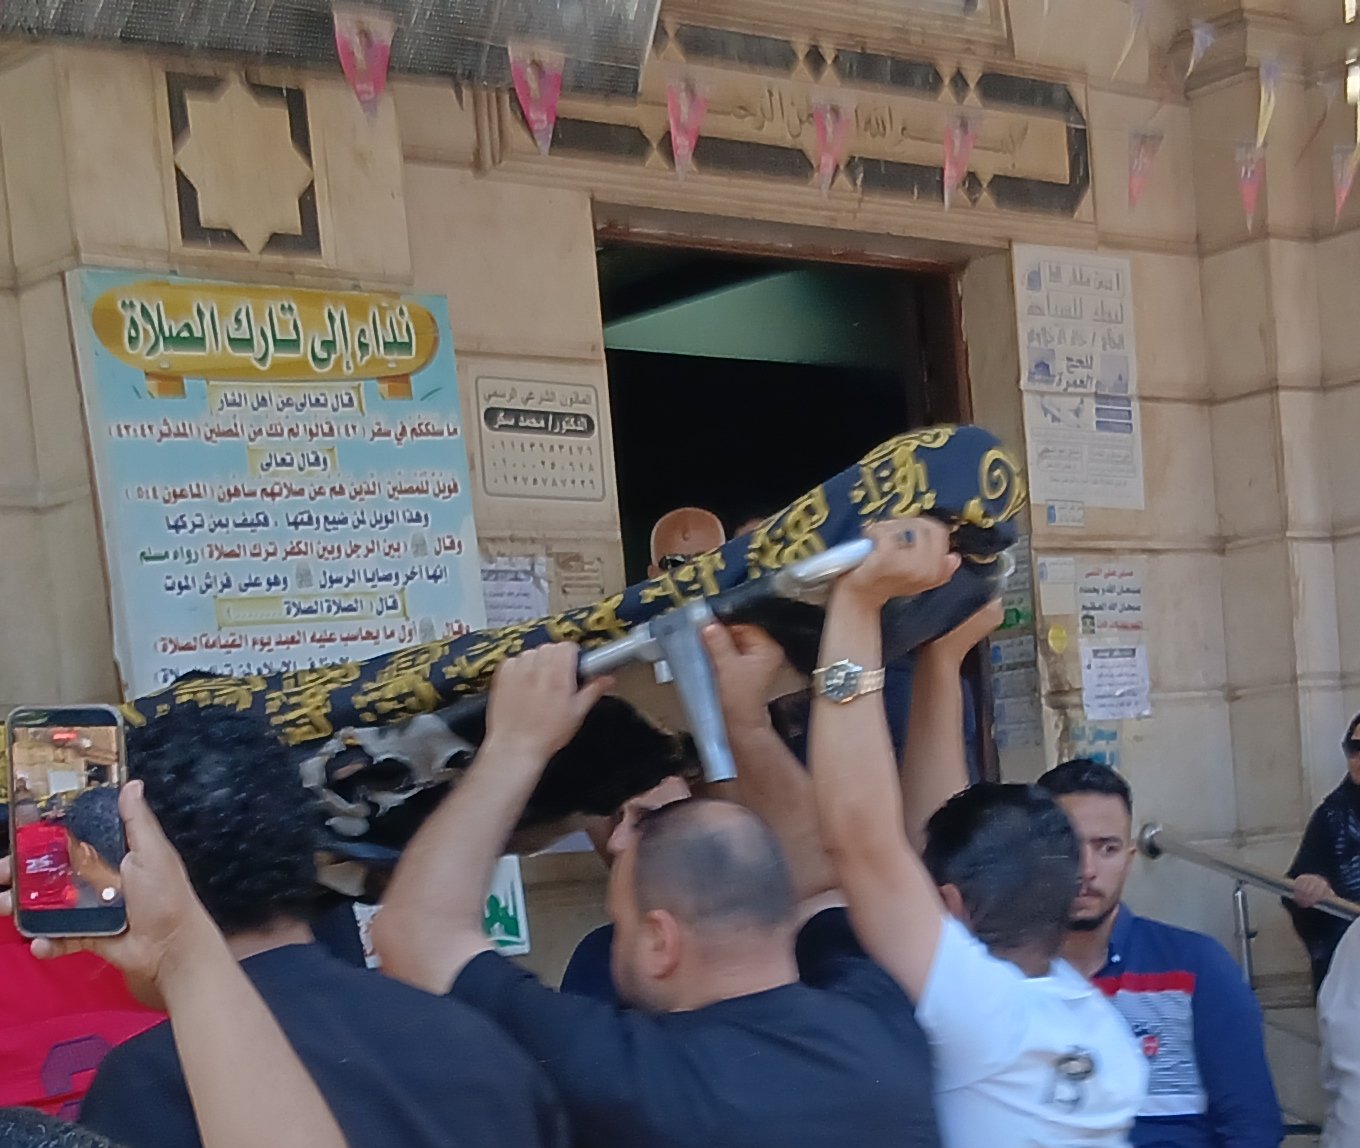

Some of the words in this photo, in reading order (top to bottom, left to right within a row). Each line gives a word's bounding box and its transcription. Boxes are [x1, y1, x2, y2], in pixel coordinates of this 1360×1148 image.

[119, 299, 221, 360] الصلاة
[225, 300, 305, 369] تارك
[309, 305, 353, 373] إلى
[356, 302, 415, 363] نداء
[216, 391, 249, 412] النار
[275, 394, 294, 412] عن
[294, 391, 328, 413] تعالى
[330, 391, 356, 413] قال
[203, 419, 246, 445] المصلين
[287, 422, 300, 441] لم
[303, 420, 336, 443] قالوا
[369, 420, 392, 442] سقر
[446, 423, 459, 438] ما
[518, 415, 546, 429] محمد
[248, 424, 264, 443] من
[259, 451, 296, 473] تعالى
[297, 451, 328, 472] وقال
[216, 482, 259, 504] ساهون
[308, 483, 327, 502] عن
[329, 482, 347, 500] هم
[165, 512, 205, 535] تركها
[208, 514, 230, 535] بمن
[232, 511, 270, 533] فكيف
[285, 509, 321, 532] وقتها
[322, 510, 349, 533] ضيع
[369, 508, 401, 531] الويل
[401, 508, 430, 529] وهذا
[139, 546, 170, 566] مسلم
[173, 546, 200, 565] رواه
[248, 541, 279, 562] ترك
[281, 540, 314, 562] الكفر
[317, 540, 343, 561] وبين
[345, 539, 381, 560] الرجل
[434, 535, 463, 557] وقال
[163, 574, 197, 596] الموت
[199, 571, 232, 595] فراش
[238, 573, 263, 593] على
[264, 573, 289, 592] وهو
[318, 568, 362, 589] الرسول
[363, 567, 400, 589] وصايا
[283, 599, 322, 618] الصلاة
[376, 594, 399, 616] قال
[274, 629, 307, 651] العبد
[310, 629, 338, 648] عليه
[340, 626, 380, 646] يحاسب
[383, 625, 396, 641] ما
[250, 635, 273, 653] يوم
